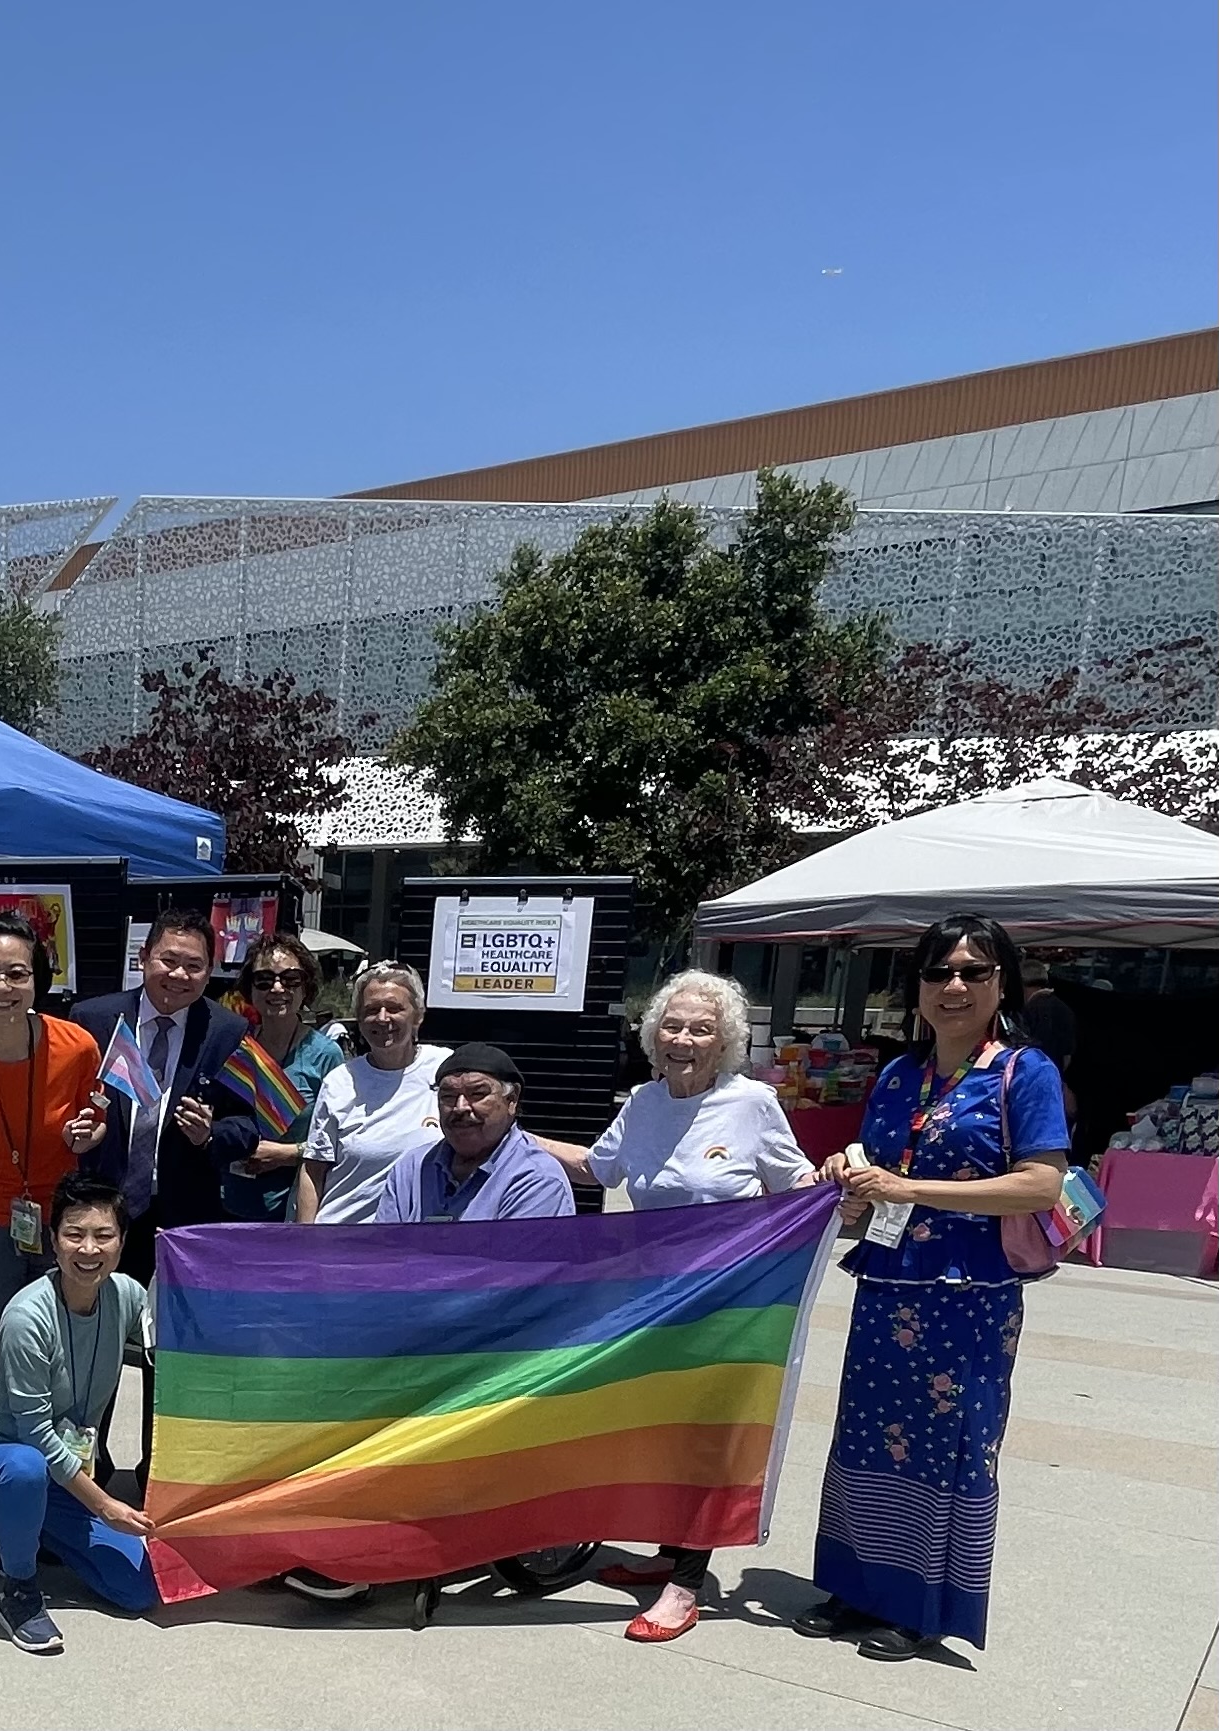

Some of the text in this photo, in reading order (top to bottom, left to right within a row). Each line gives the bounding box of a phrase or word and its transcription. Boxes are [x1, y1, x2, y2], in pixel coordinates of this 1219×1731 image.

[482, 933, 556, 949] LGBTQ+
[481, 950, 553, 959] HEALTHCARE
[480, 961, 553, 973] EQUALITY
[474, 978, 534, 989] LEADER
